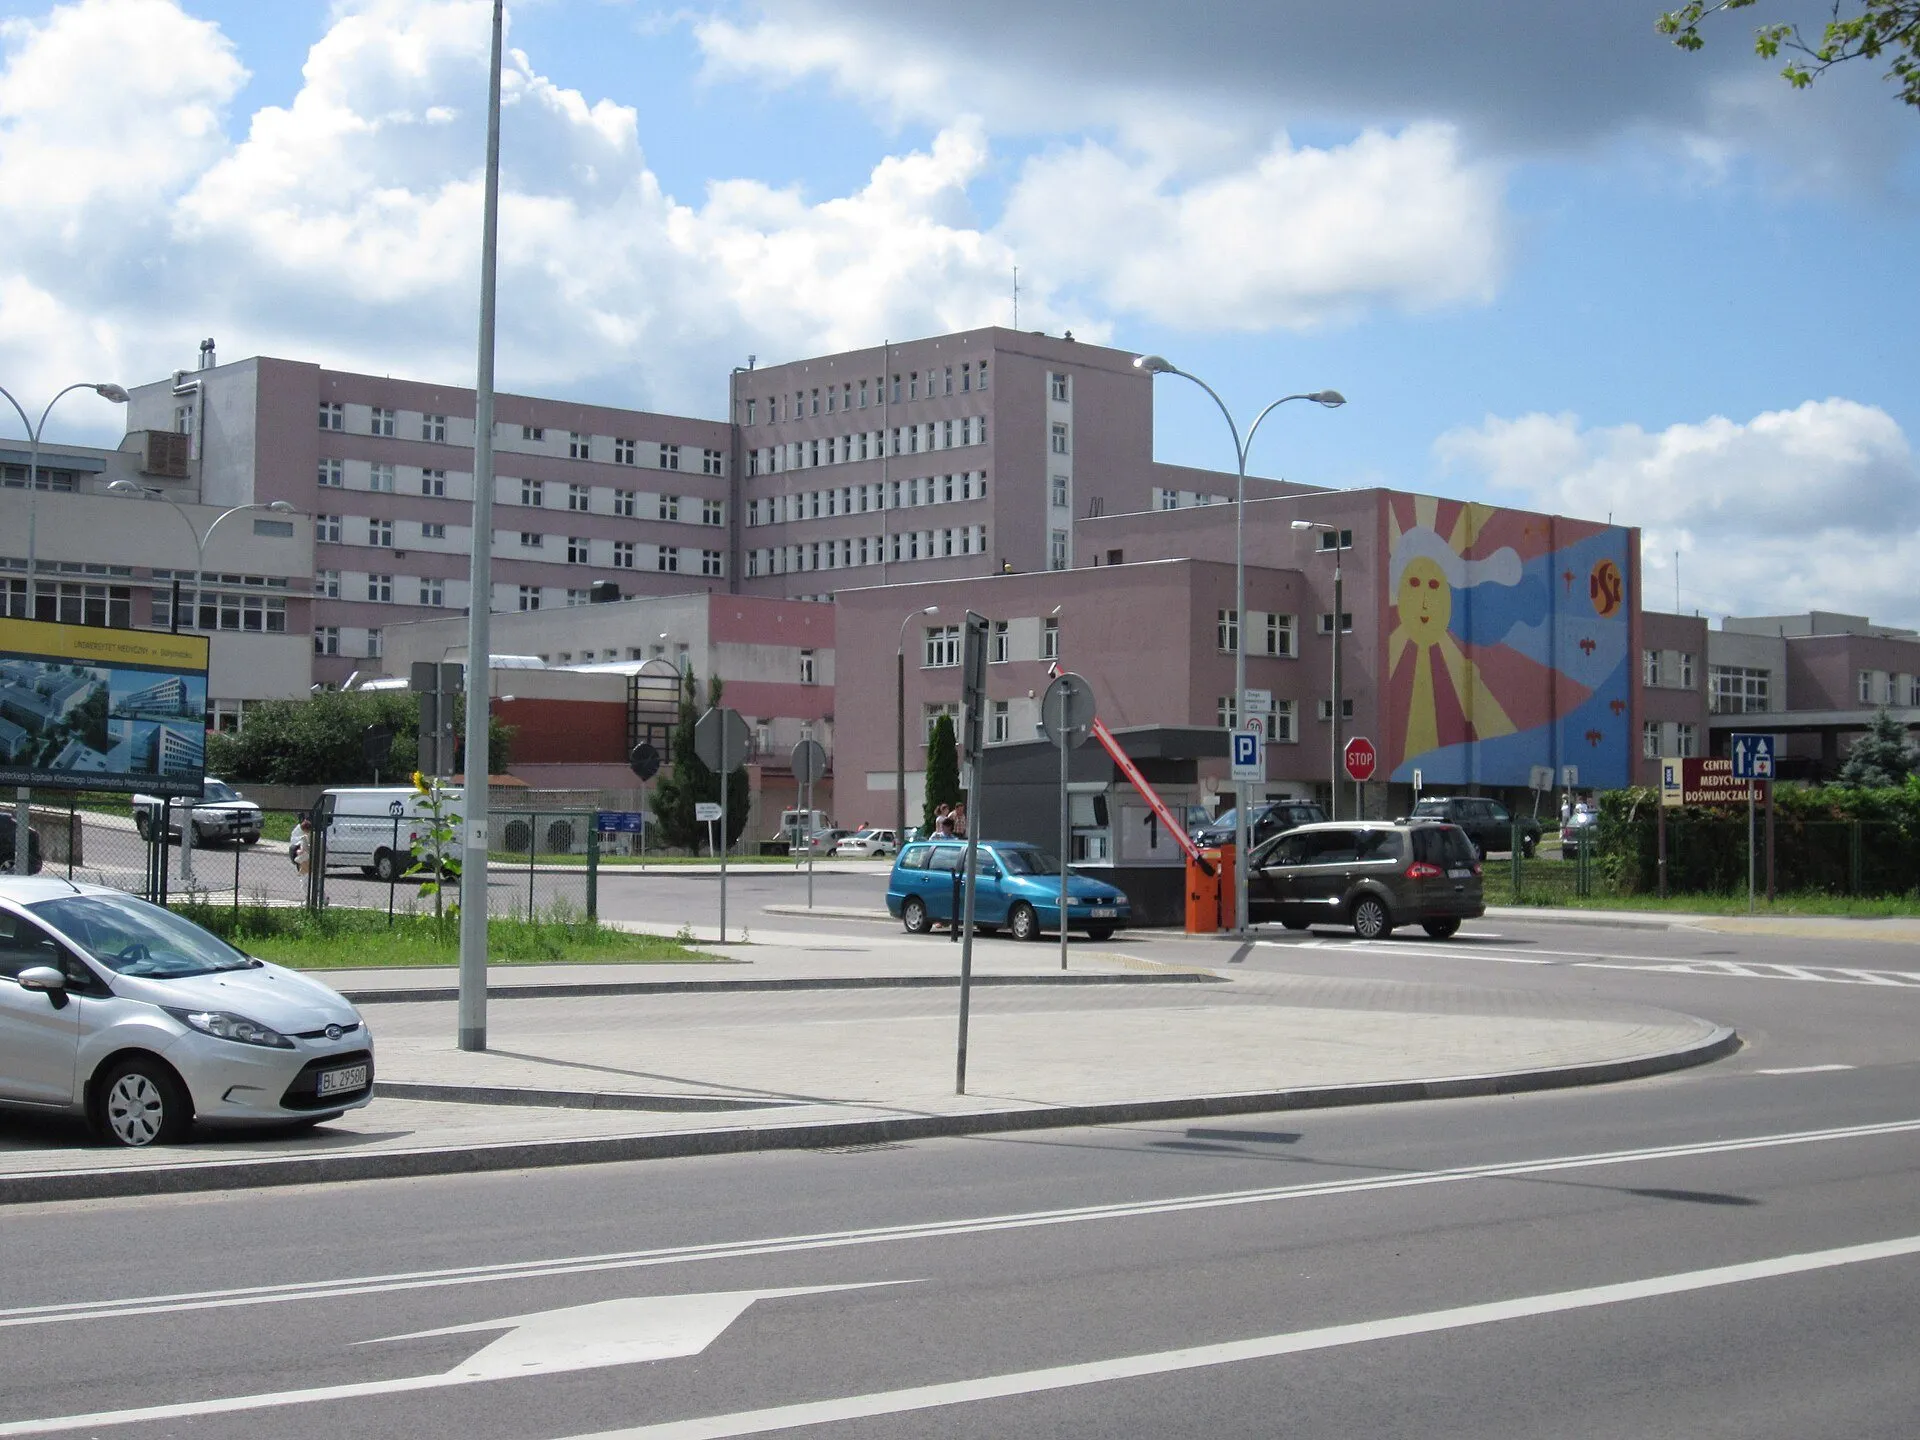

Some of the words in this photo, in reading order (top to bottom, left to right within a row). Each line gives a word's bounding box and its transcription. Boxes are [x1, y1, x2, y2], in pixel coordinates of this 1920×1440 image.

[73, 640, 116, 651] UNIWERSYTET
[117, 643, 149, 656] MEDYCZNY
[1239, 738, 1253, 762] P
[1348, 752, 1373, 766] STOP
[87, 776, 123, 788] Uniwersytetu
[124, 778, 158, 790] Medycznego
[1144, 810, 1157, 848] 1
[323, 1074, 336, 1089] BL
[340, 1067, 365, 1087] 29500
